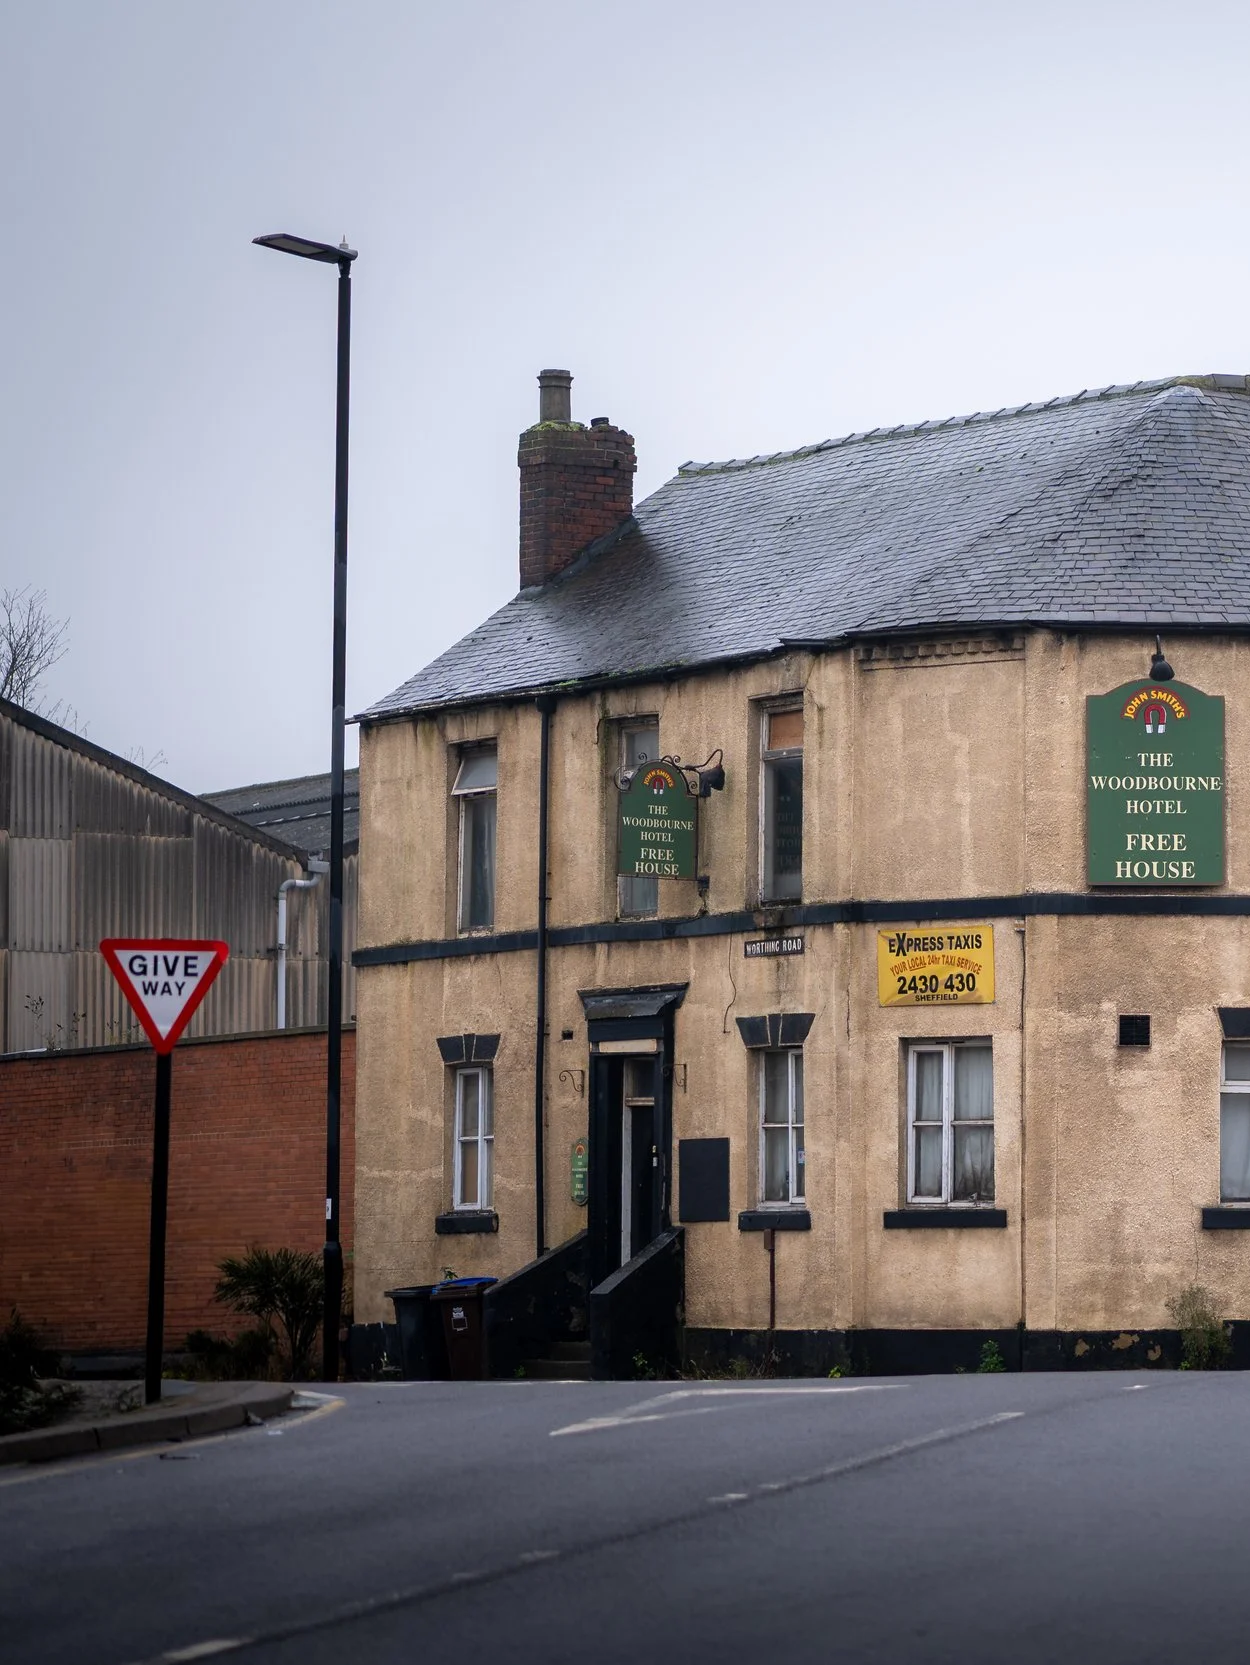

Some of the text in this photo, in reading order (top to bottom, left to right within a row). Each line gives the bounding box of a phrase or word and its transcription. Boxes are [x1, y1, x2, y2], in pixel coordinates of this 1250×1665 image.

[1124, 690, 1185, 719] JOHN SMITH'S
[1137, 753, 1174, 766] THE
[643, 770, 656, 785] JOHN
[1091, 776, 1222, 790] WOODBOURNE
[648, 804, 669, 815] THE
[1126, 800, 1187, 814] HOTEL
[622, 816, 694, 830] WOODBOURNE
[640, 831, 675, 842] HOTEL
[1126, 833, 1187, 851] FREE
[640, 847, 674, 861] FREE
[635, 861, 680, 876] HOUSE
[1115, 861, 1195, 879] HOUSE
[782, 939, 801, 951] ROAD
[889, 933, 982, 956] EXPRESS TAXIS
[129, 955, 198, 977] GIVE
[889, 954, 983, 977] YOUR LOCAL 24hr TAXI SERVICE
[142, 981, 185, 996] WAY
[897, 973, 976, 994] 2430 430
[915, 994, 958, 1002] SHEFFIELD
